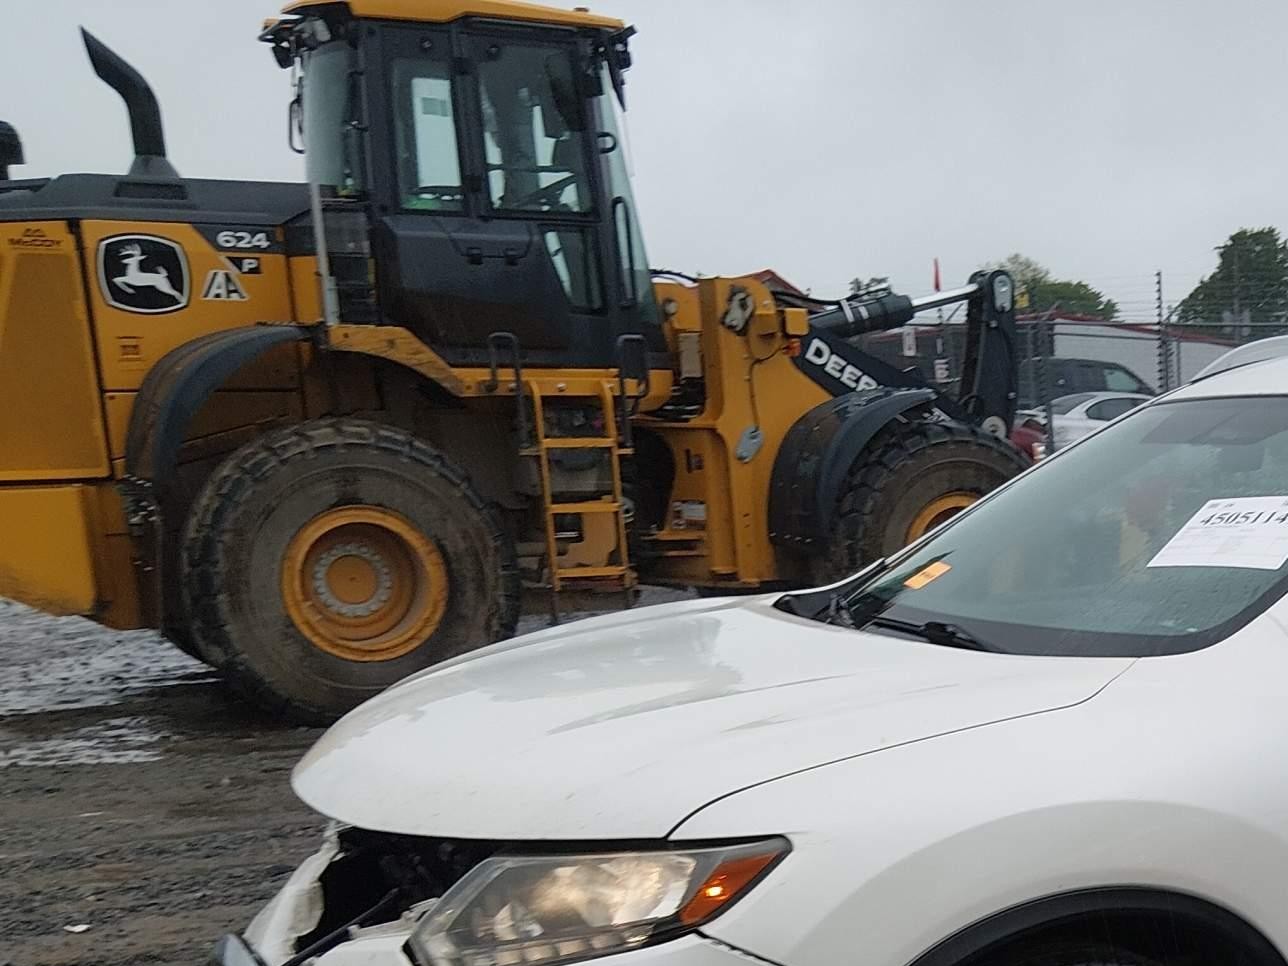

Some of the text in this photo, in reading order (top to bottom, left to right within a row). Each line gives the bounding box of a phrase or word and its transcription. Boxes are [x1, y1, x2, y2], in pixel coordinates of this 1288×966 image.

[216, 231, 271, 248] 624
[242, 258, 258, 272] P
[805, 337, 884, 391] DEER
